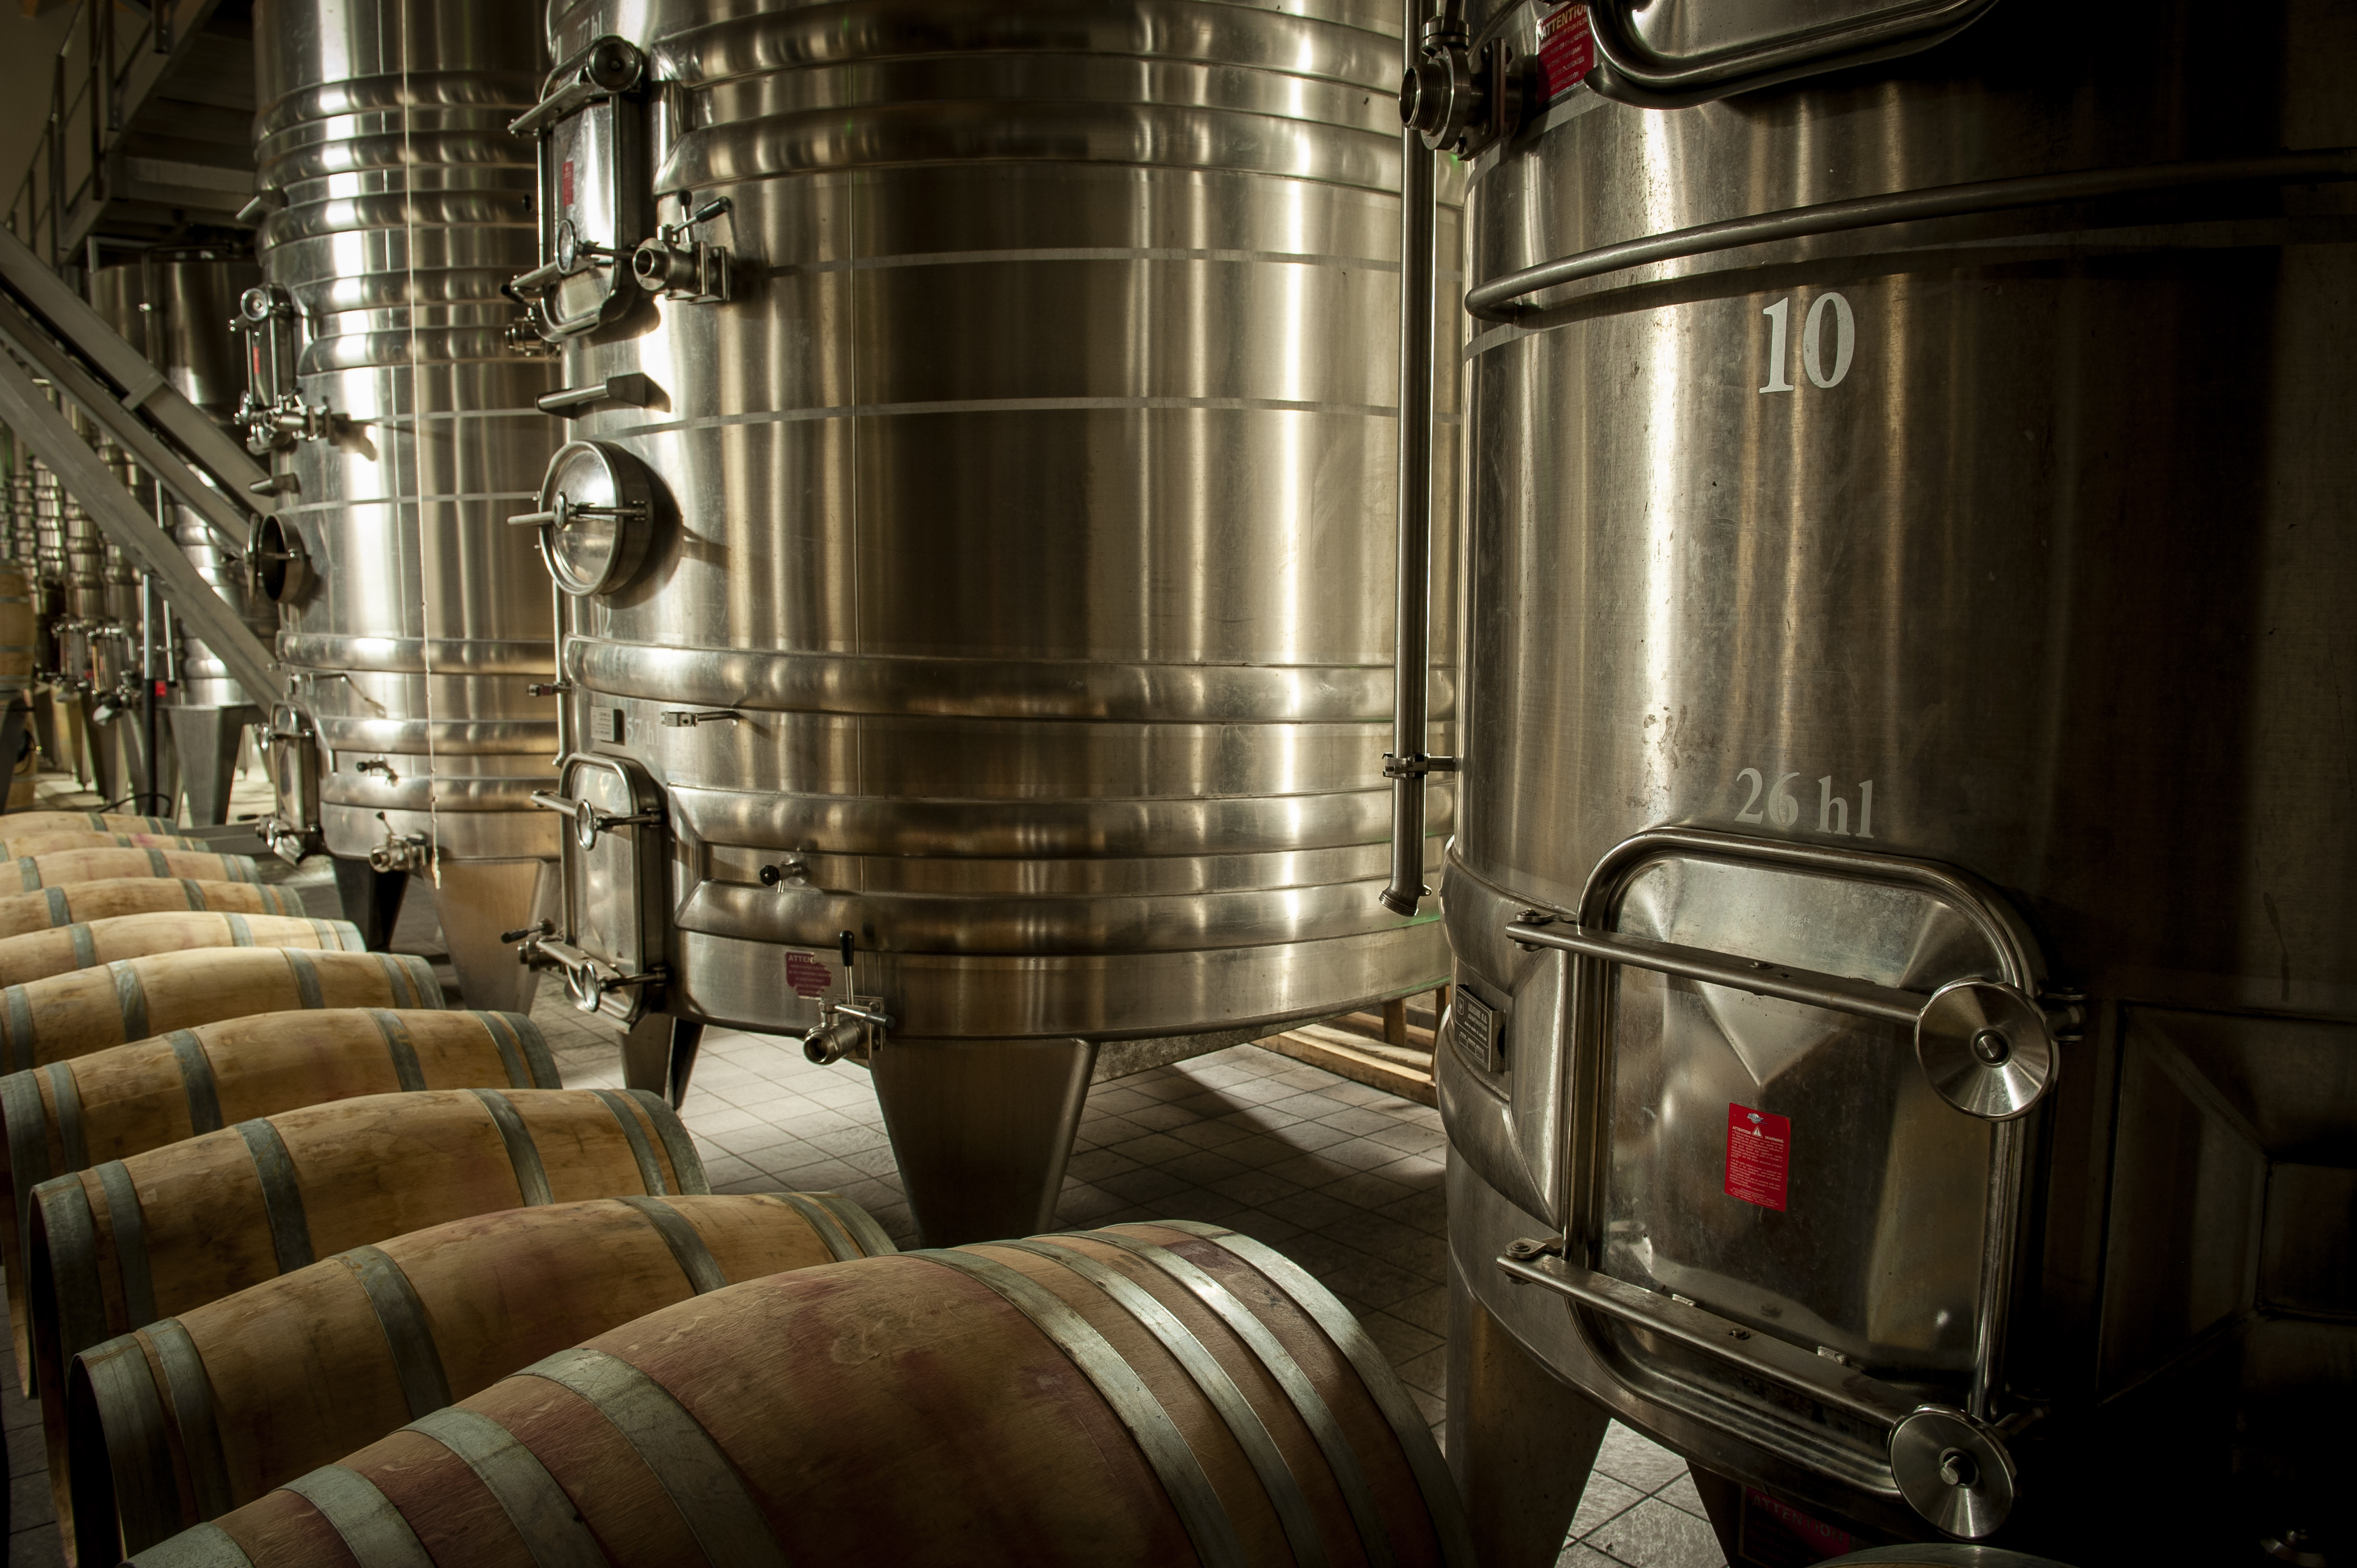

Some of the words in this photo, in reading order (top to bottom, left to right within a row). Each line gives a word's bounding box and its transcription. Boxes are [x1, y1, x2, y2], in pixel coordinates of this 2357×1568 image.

[577, 17, 589, 49] 77
[1759, 292, 1855, 394] 10
[1734, 767, 1800, 827] 26
[1815, 775, 1874, 839] hl
[1751, 1494, 1843, 1543] ATTENTION
